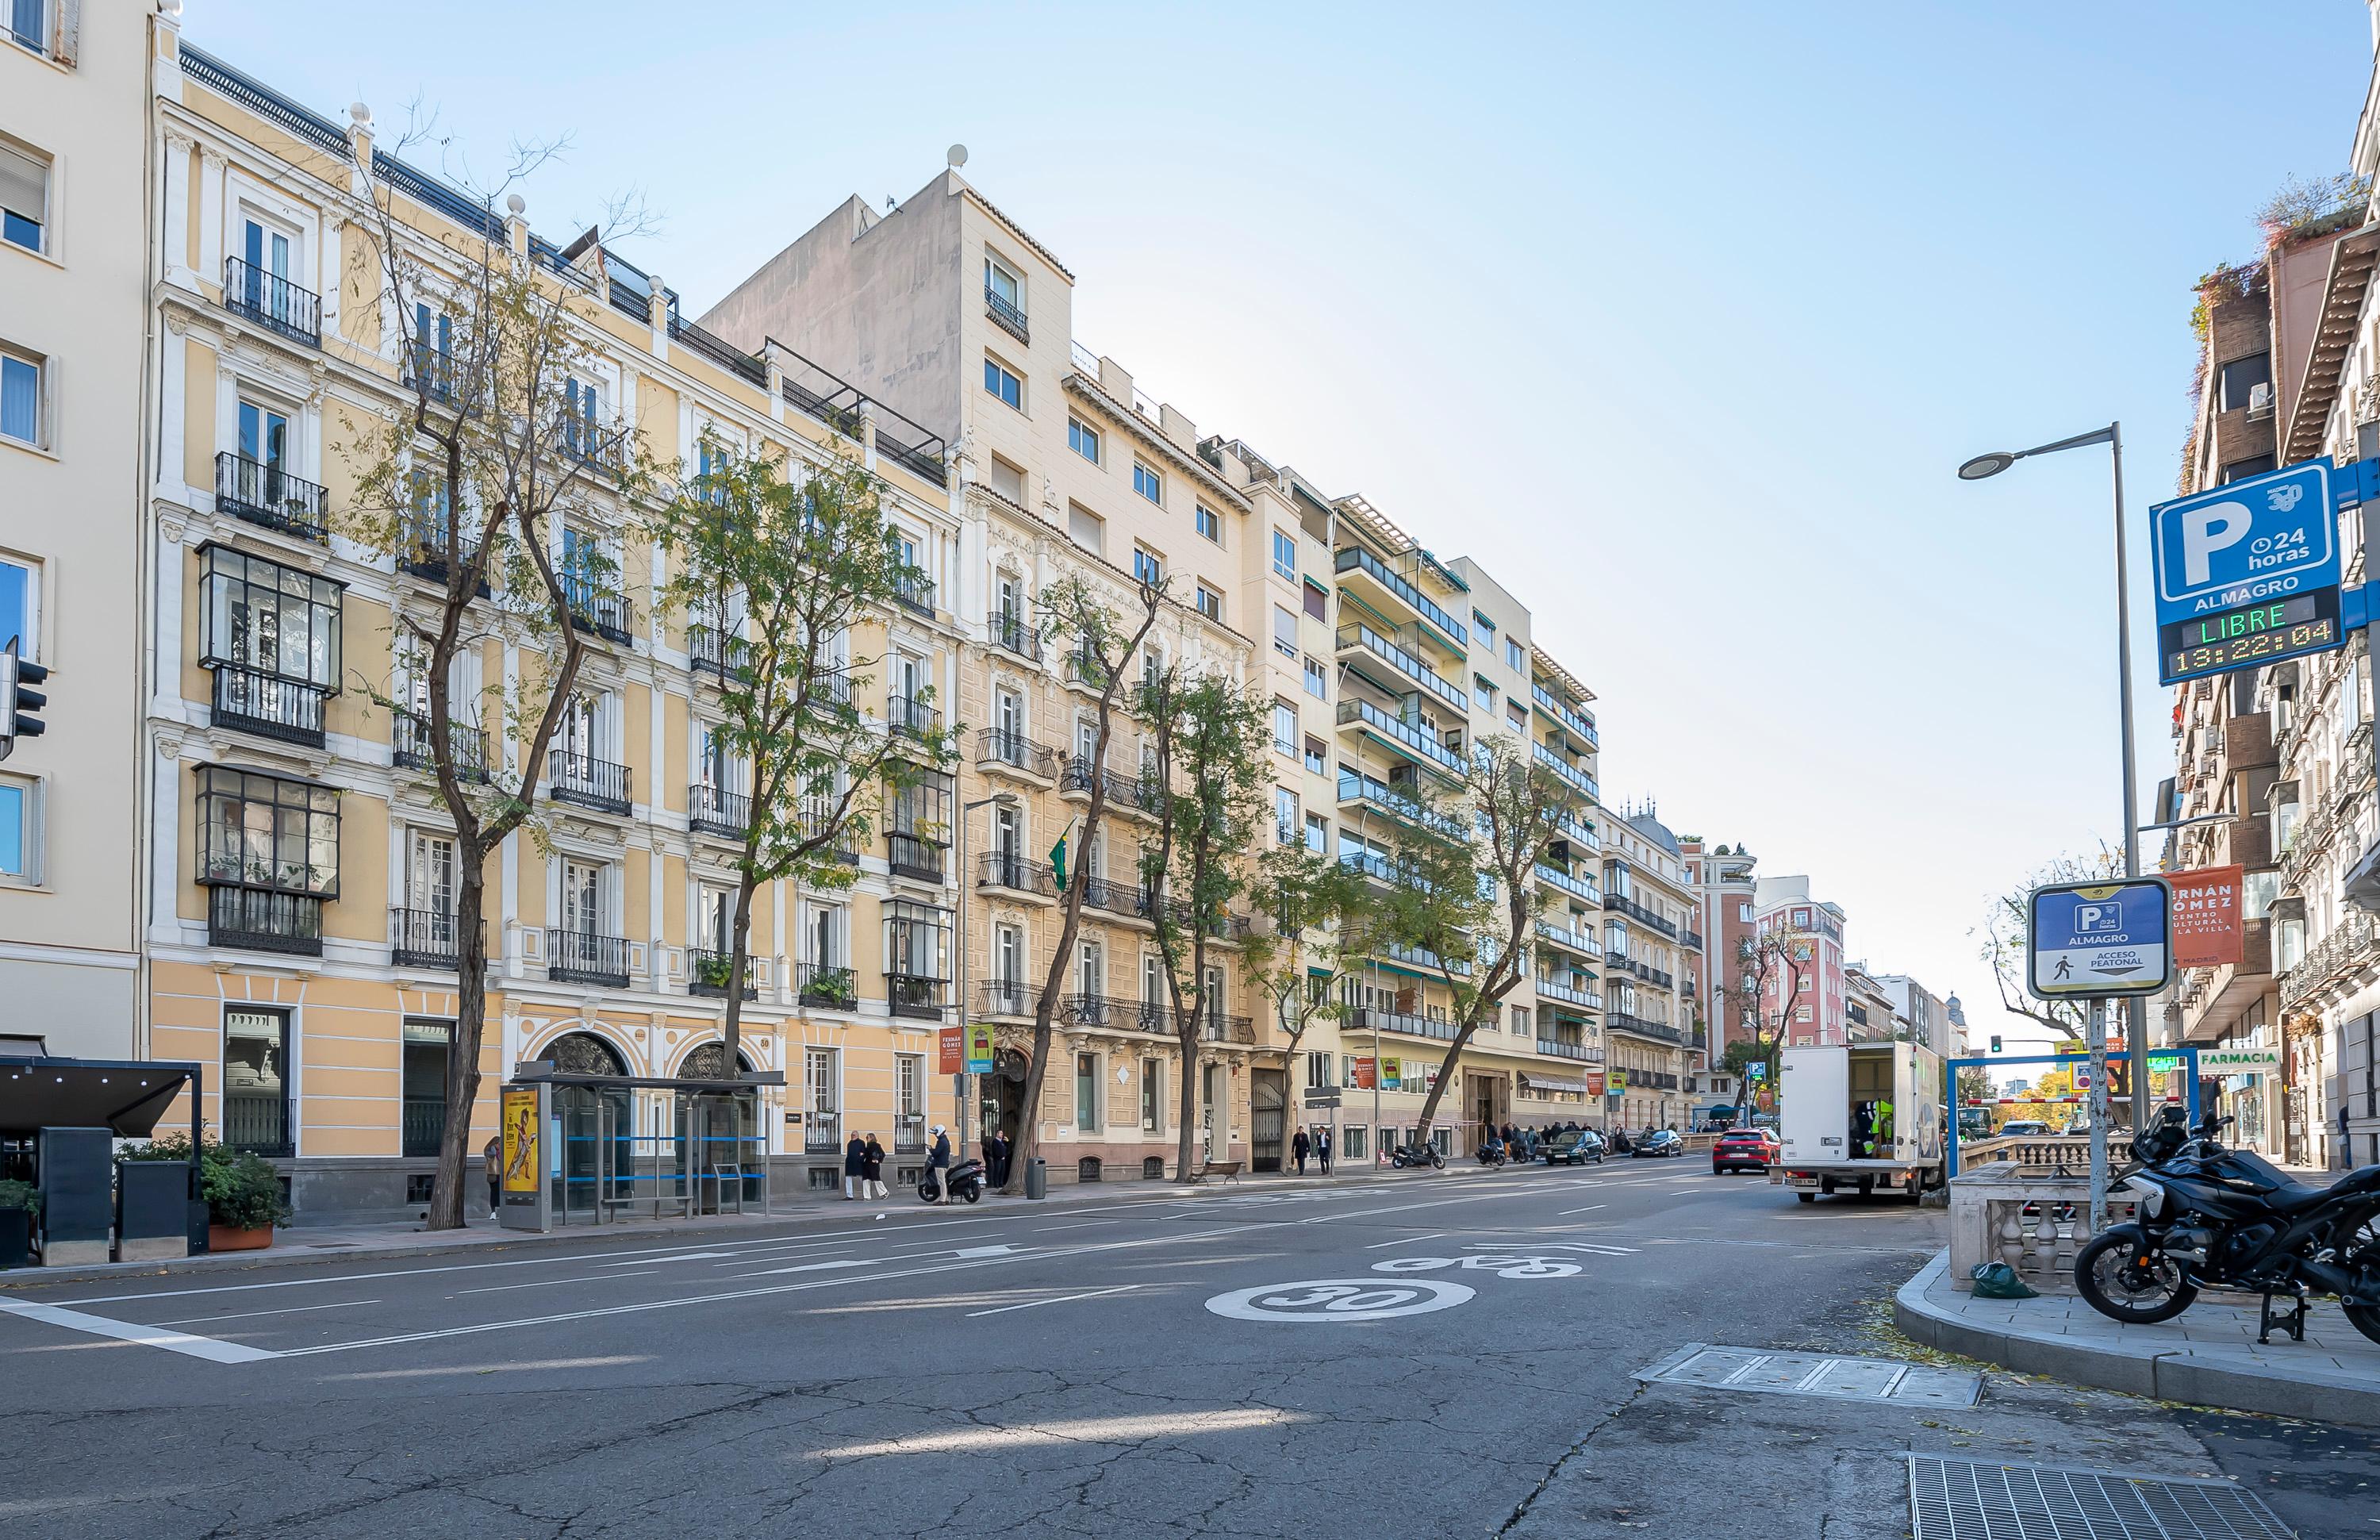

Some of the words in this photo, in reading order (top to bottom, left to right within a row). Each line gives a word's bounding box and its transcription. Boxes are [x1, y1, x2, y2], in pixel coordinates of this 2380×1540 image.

[2182, 501, 2252, 586] P
[2274, 528, 2305, 550] 24
[2248, 546, 2309, 570] horas
[2194, 577, 2299, 613] ALMAGRO
[2202, 604, 2286, 643] LIBRE
[2177, 620, 2332, 672] 13:22:04
[2172, 885, 2232, 900] ERNÁN
[2173, 897, 2231, 912] ÓMEZ
[2082, 907, 2102, 931] P
[2173, 912, 2217, 920] CENTRO
[2173, 919, 2223, 927] ULTURAL
[2068, 934, 2129, 946] ALMAGRO
[2097, 950, 2136, 959] ACCESO
[2090, 958, 2143, 967] PEATONAL
[2202, 1053, 2276, 1065] FARMACIA
[2144, 1191, 2158, 1201] GS
[1261, 1285, 1418, 1311] 30
